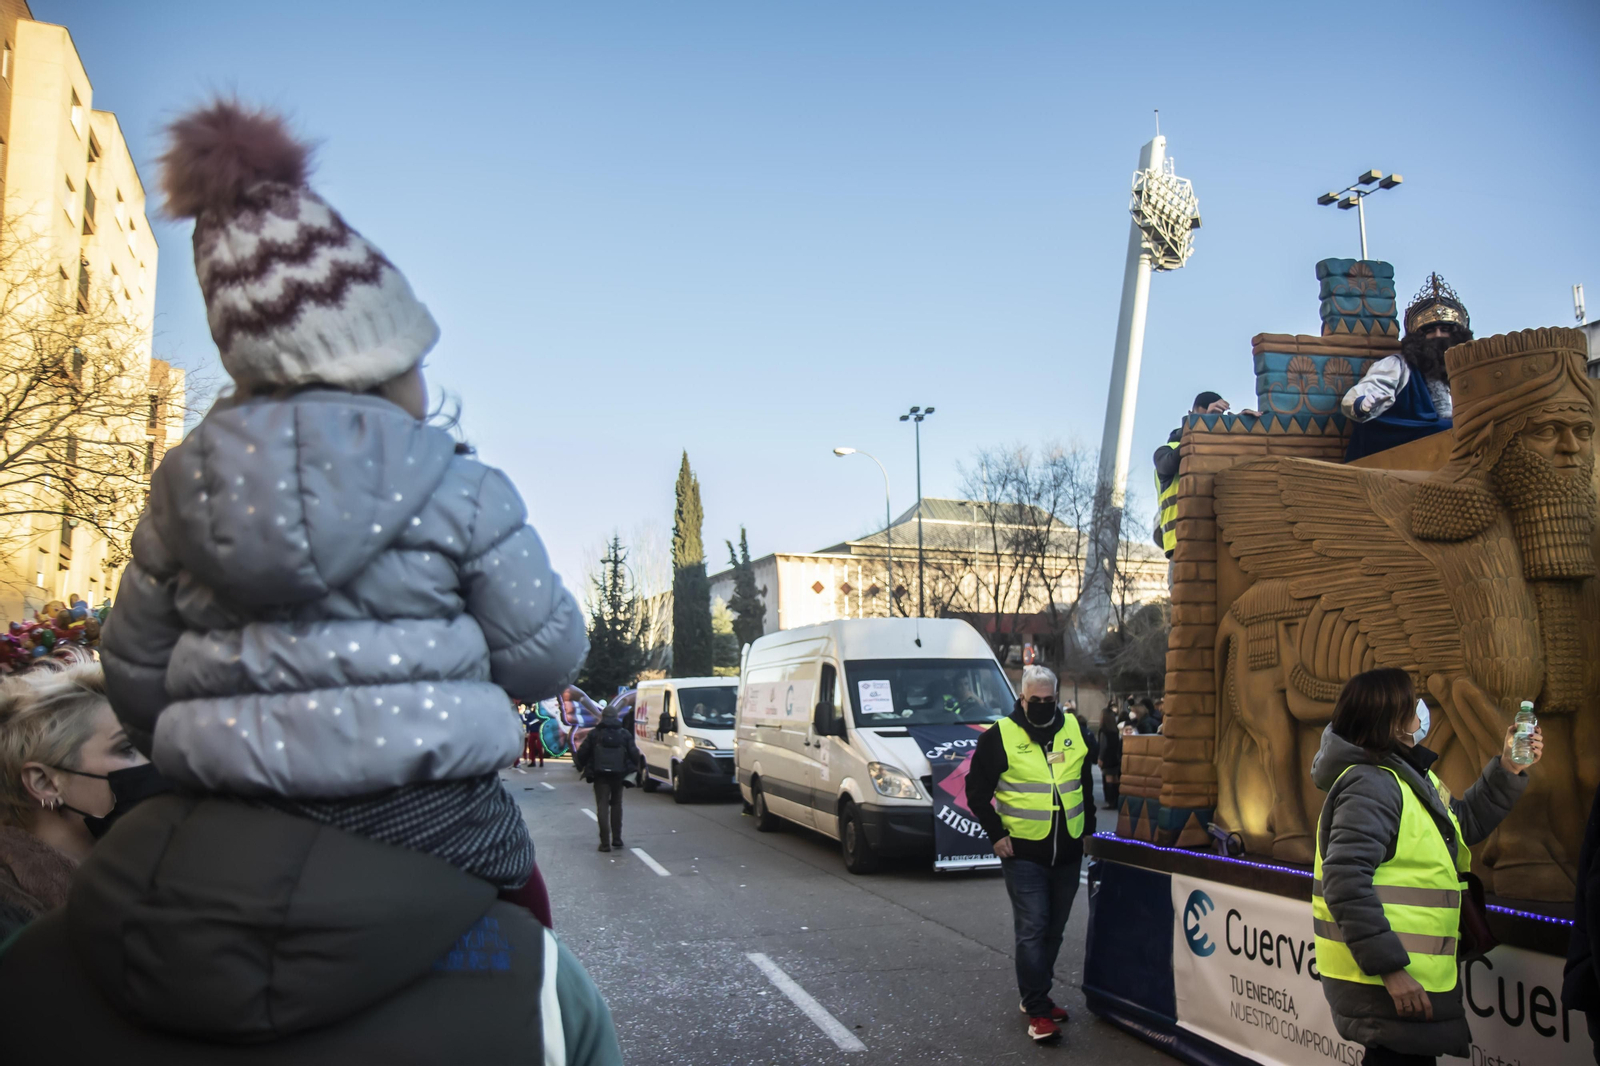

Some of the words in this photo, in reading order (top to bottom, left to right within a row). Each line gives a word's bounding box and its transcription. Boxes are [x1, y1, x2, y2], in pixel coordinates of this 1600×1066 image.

[926, 739, 979, 759] CAPOT
[1229, 974, 1244, 996] TU
[1230, 1001, 1279, 1035] NUESTRO
